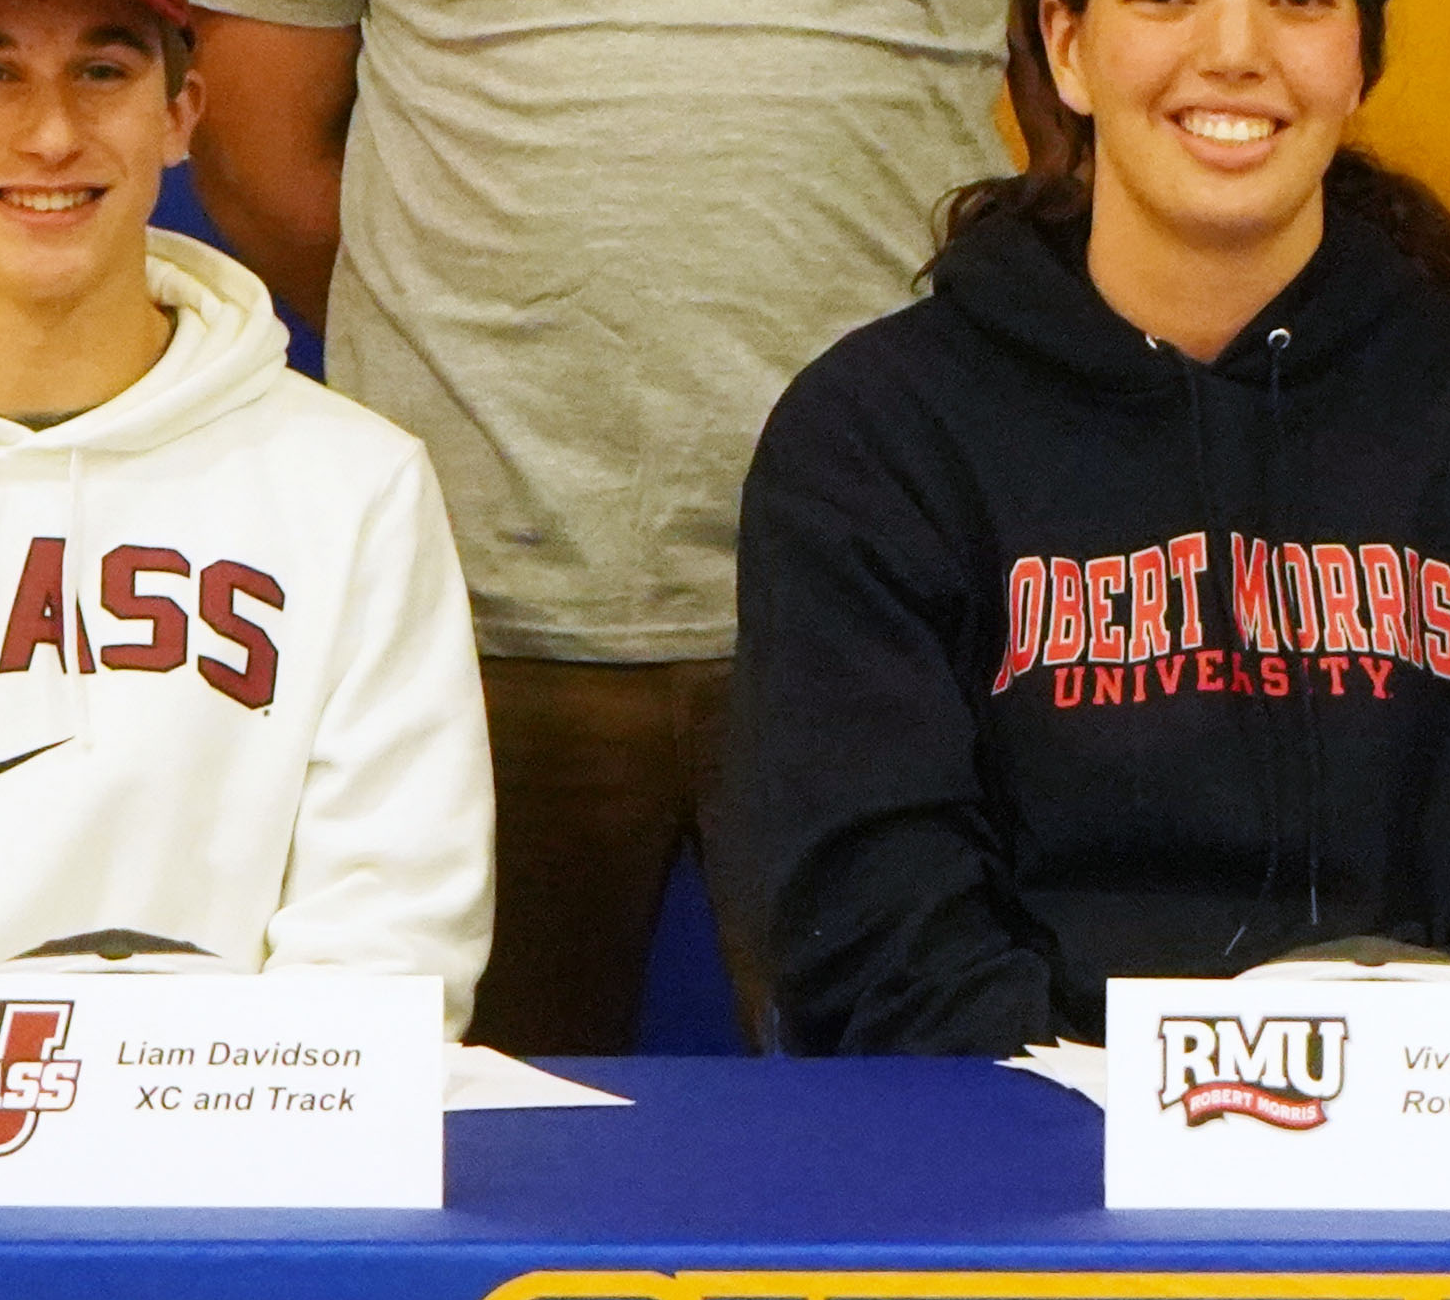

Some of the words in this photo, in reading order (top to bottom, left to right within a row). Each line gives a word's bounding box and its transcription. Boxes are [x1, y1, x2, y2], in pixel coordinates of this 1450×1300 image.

[991, 531, 1207, 696] OBERT
[116, 1041, 195, 1067] Liam
[208, 1041, 362, 1067] Davidson
[1157, 1015, 1349, 1110] RMU
[135, 1086, 182, 1111] XC
[194, 1086, 253, 1111] and
[268, 1086, 356, 1111] Track
[1190, 1088, 1254, 1112] ROBERT
[1258, 1096, 1318, 1120] MORRIS
